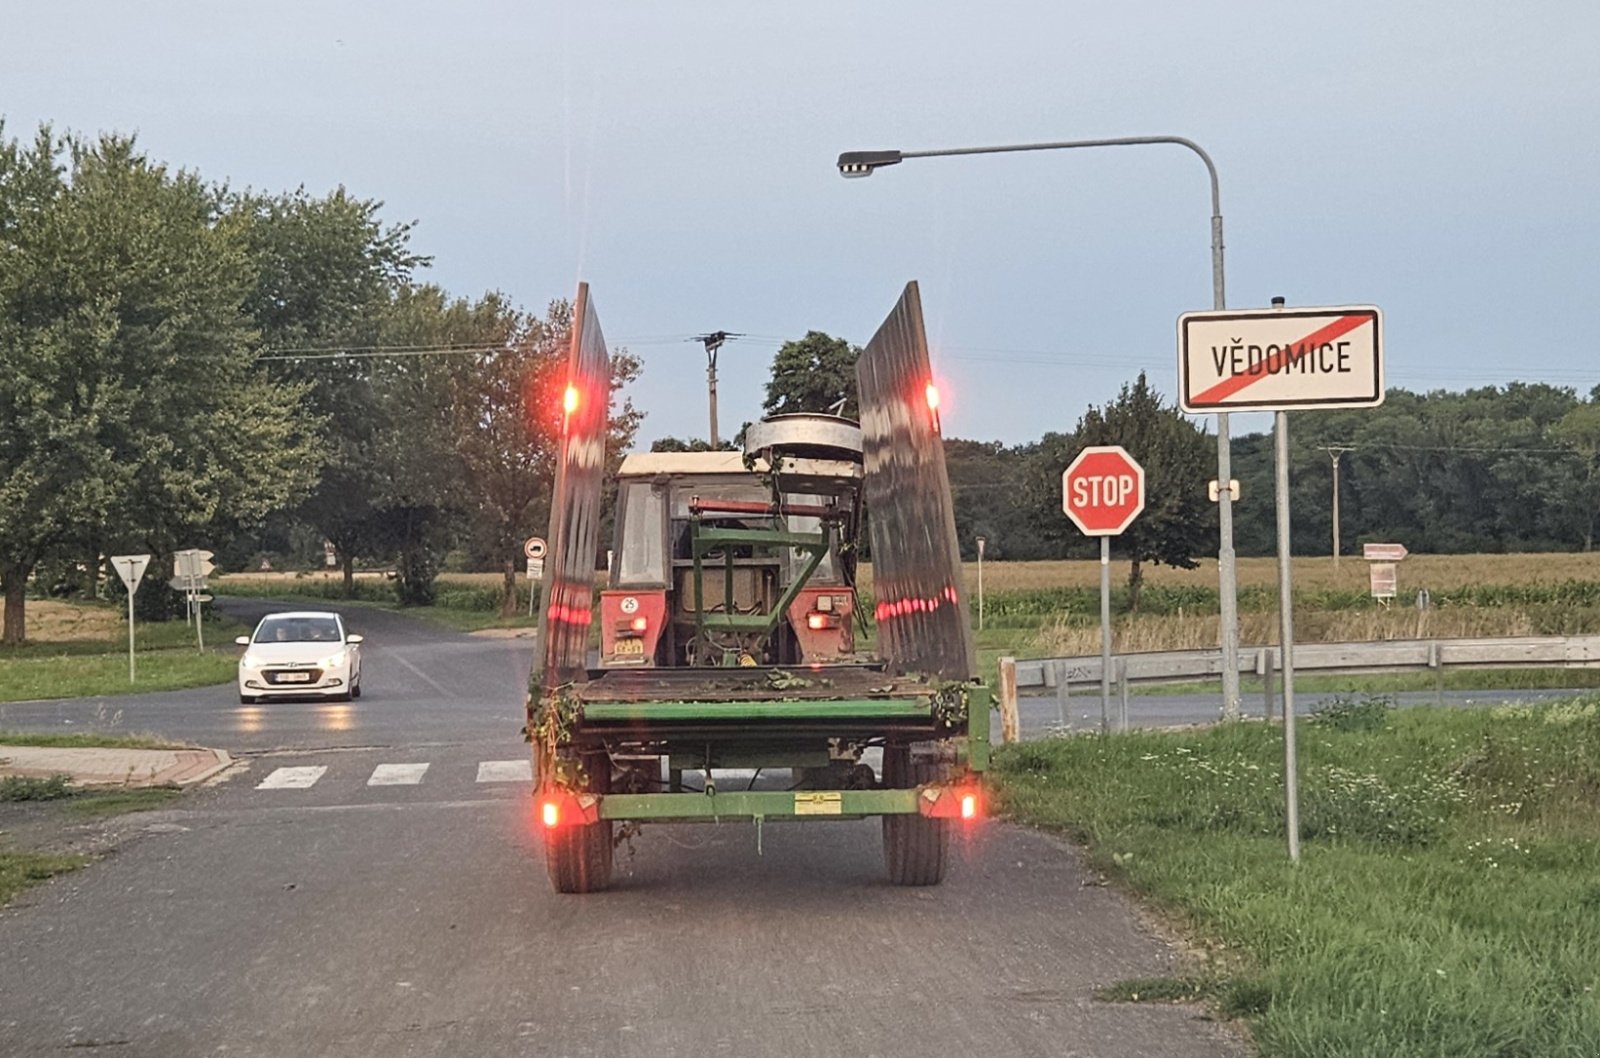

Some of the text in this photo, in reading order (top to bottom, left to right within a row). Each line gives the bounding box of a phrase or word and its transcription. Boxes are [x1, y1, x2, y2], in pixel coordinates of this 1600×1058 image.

[1211, 337, 1351, 377] VĚDOMICE
[1072, 474, 1134, 508] STOP
[624, 599, 635, 609] 25
